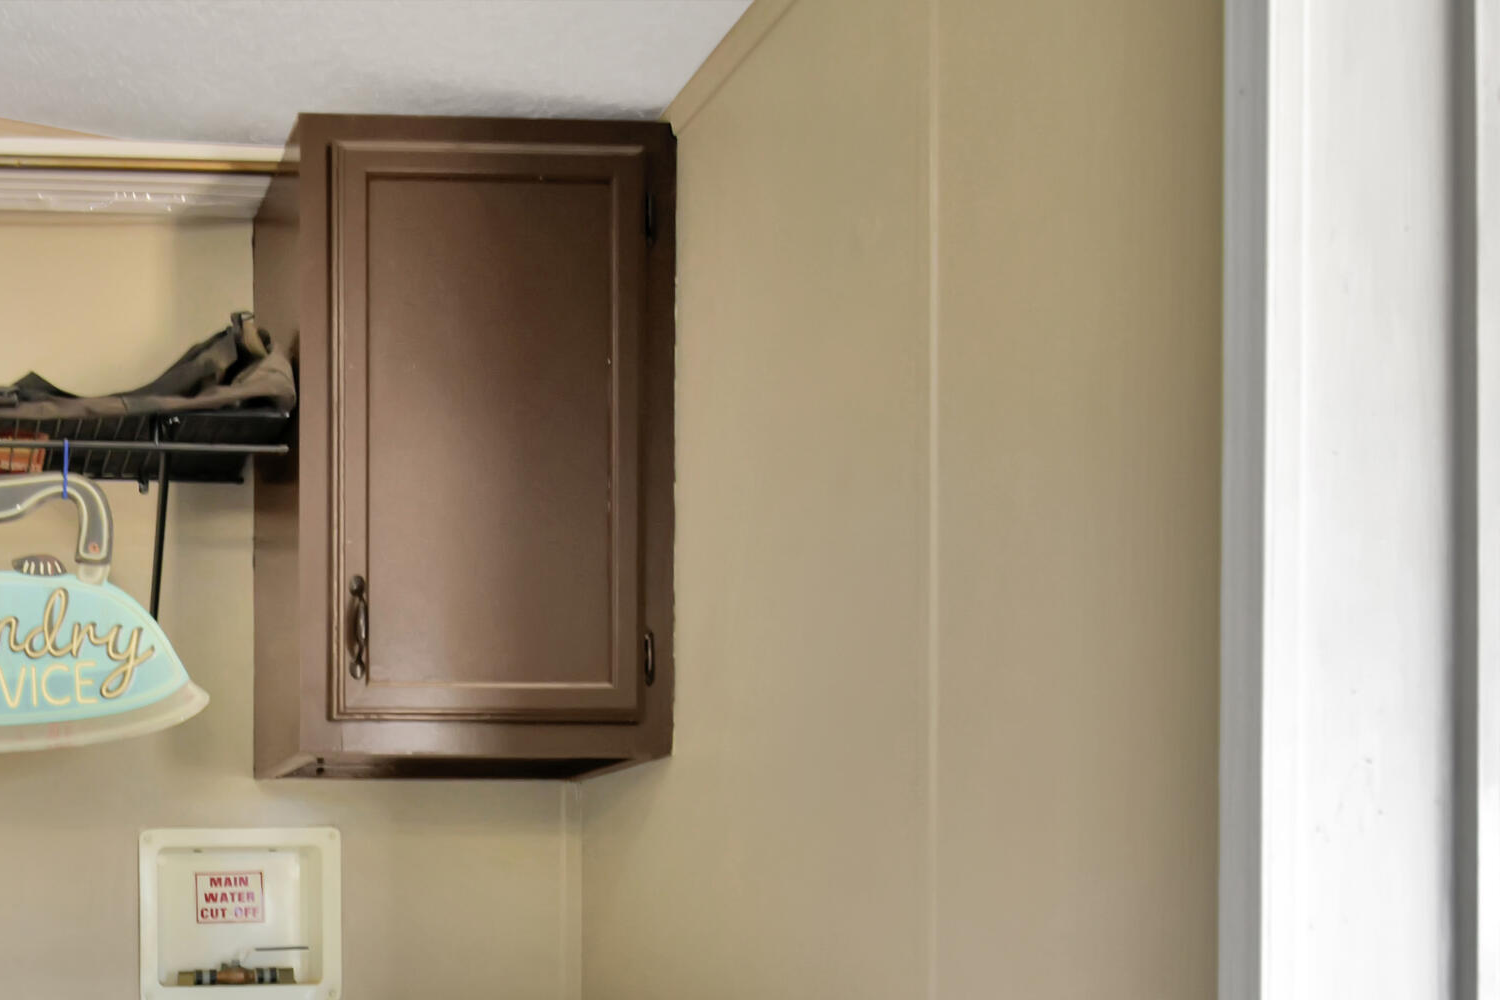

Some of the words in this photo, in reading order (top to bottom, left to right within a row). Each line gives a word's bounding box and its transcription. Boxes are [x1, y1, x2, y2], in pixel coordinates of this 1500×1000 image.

[209, 876, 249, 888] MAIN
[204, 891, 255, 903] WATER
[200, 908, 227, 919] CUT
[234, 907, 260, 919] OFF
